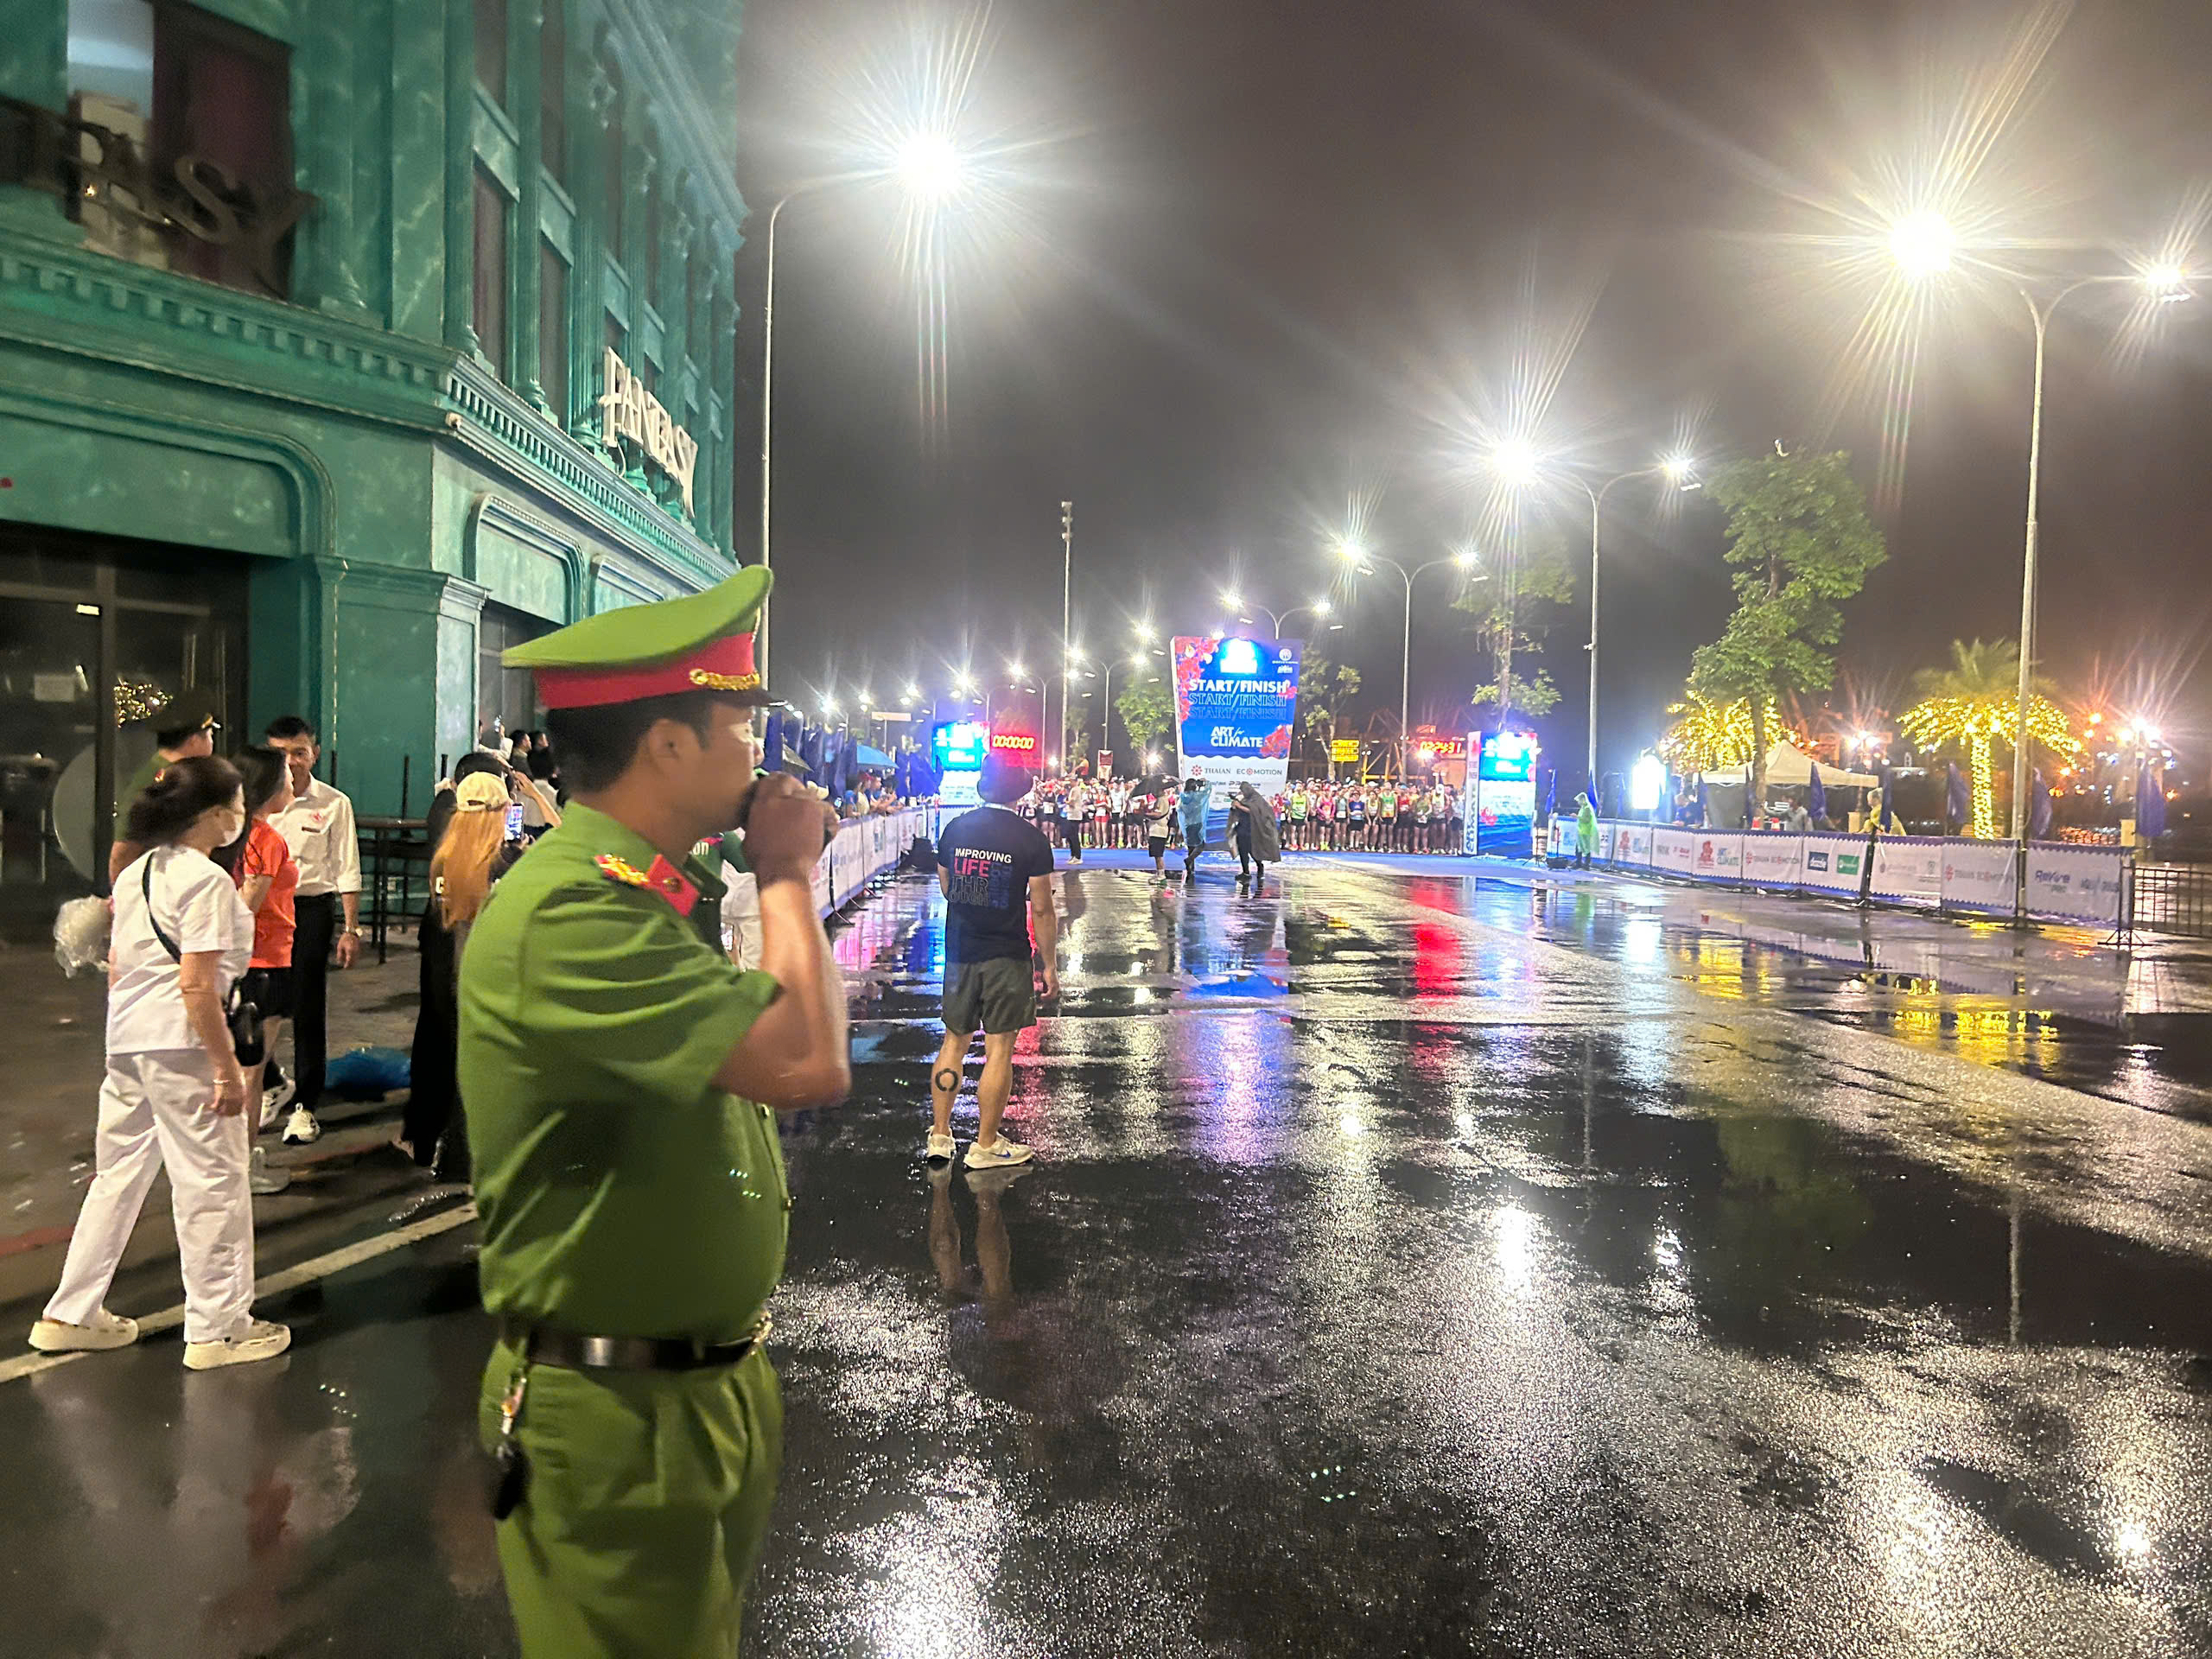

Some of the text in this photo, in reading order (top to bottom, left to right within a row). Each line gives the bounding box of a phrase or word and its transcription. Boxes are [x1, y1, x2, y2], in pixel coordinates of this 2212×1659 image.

[602, 346, 698, 518] FANTASY
[1188, 679, 1287, 695] START/FINISH
[1188, 693, 1287, 708] START/FINISH
[1211, 726, 1234, 737] ART
[992, 735, 1035, 750] 00:00:00
[1211, 737, 1263, 748] CLIMATE
[955, 848, 1012, 864] IMPROVING
[953, 857, 991, 878] LIFE
